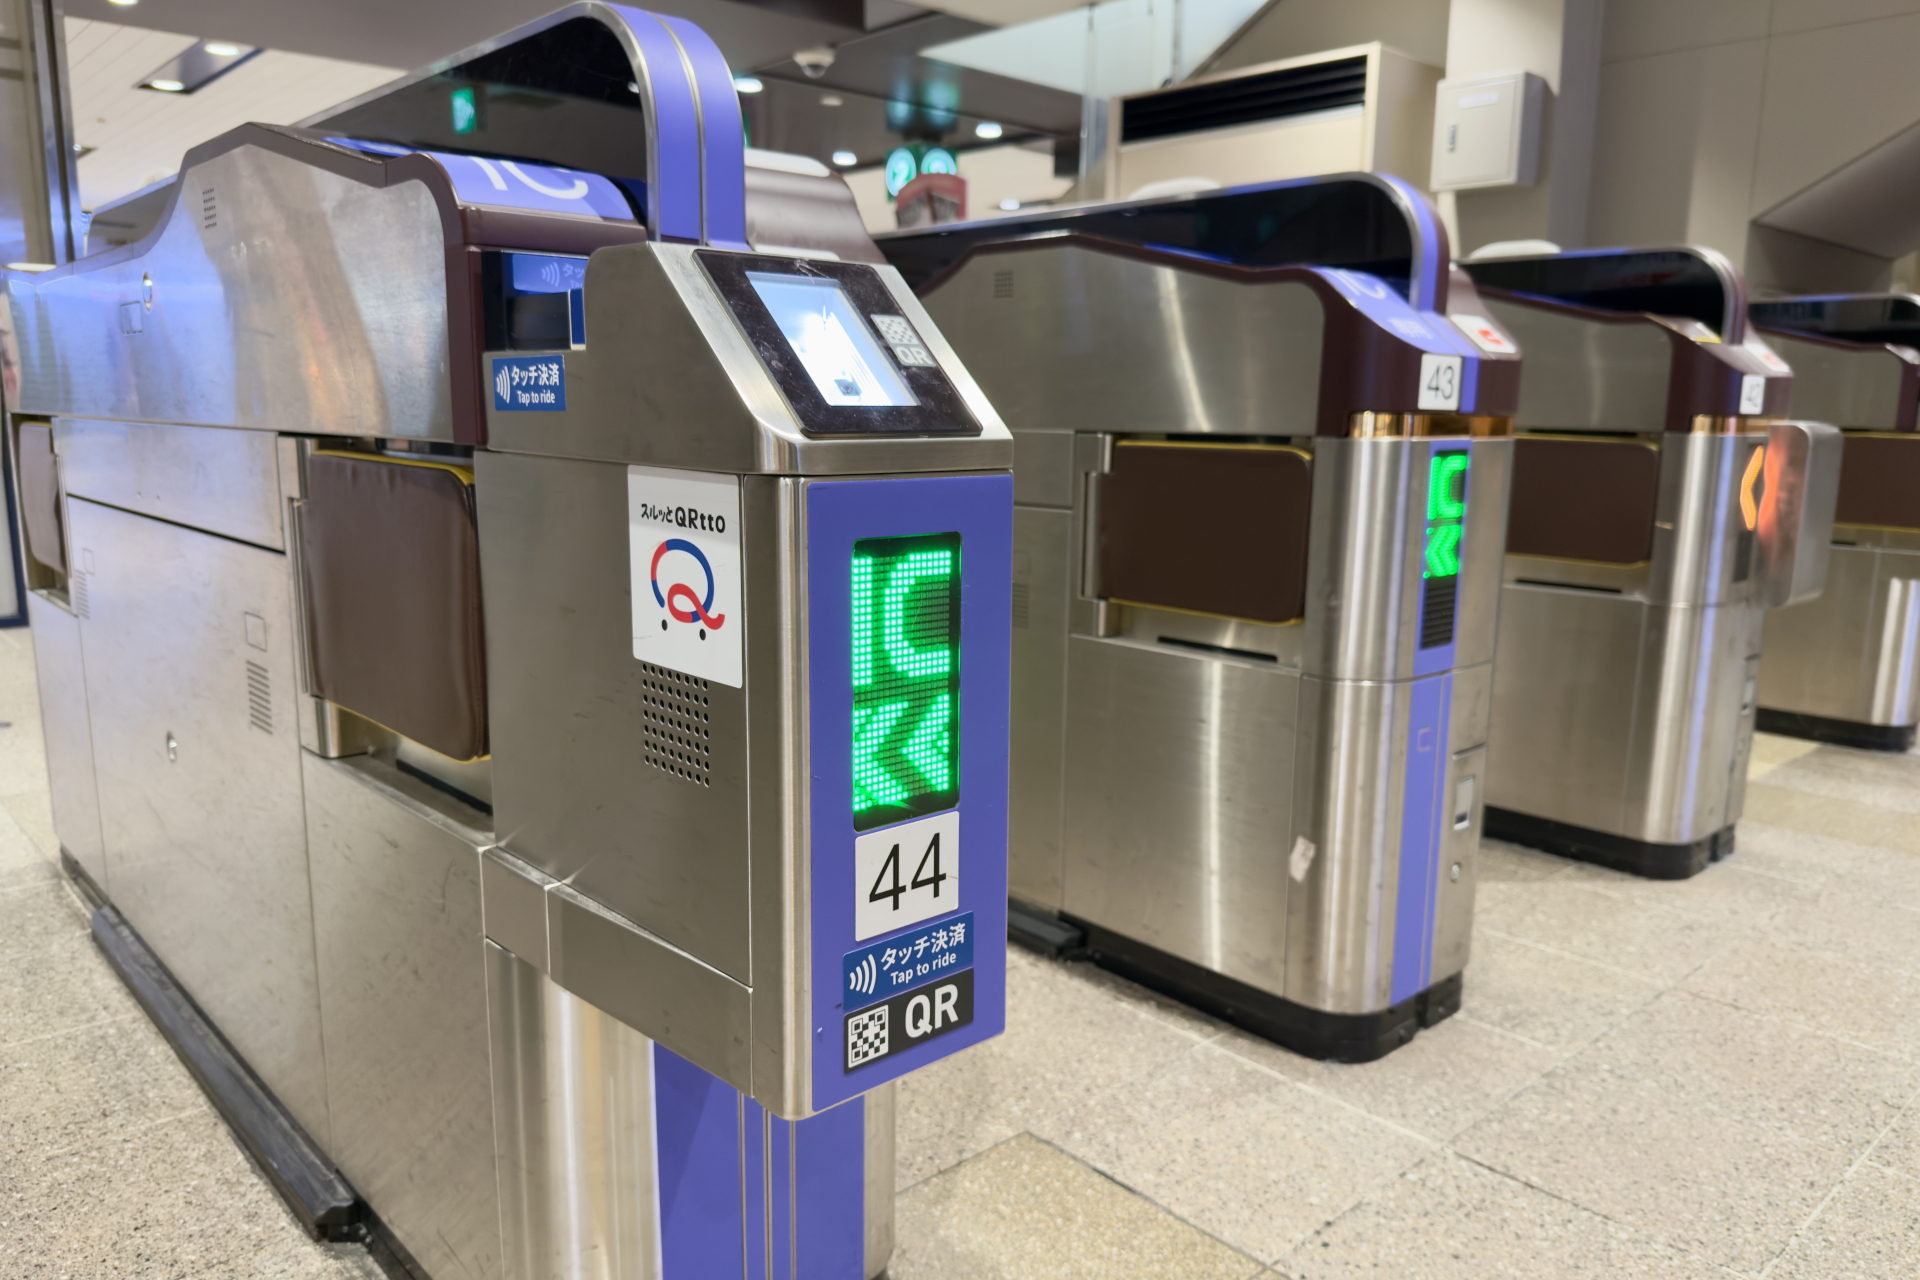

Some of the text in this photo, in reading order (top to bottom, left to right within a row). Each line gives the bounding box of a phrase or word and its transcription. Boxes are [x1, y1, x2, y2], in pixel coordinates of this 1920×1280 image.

[511, 363, 560, 387] タッチ決済
[896, 346, 933, 365] QR
[517, 389, 556, 407] Tap to ride
[1427, 364, 1455, 400] 43
[1428, 455, 1468, 520] IC
[852, 550, 951, 686] IC
[869, 832, 946, 911] 44
[881, 922, 966, 971] タッチ決済
[890, 951, 957, 985] Tap to ride
[905, 983, 959, 1039] QR
